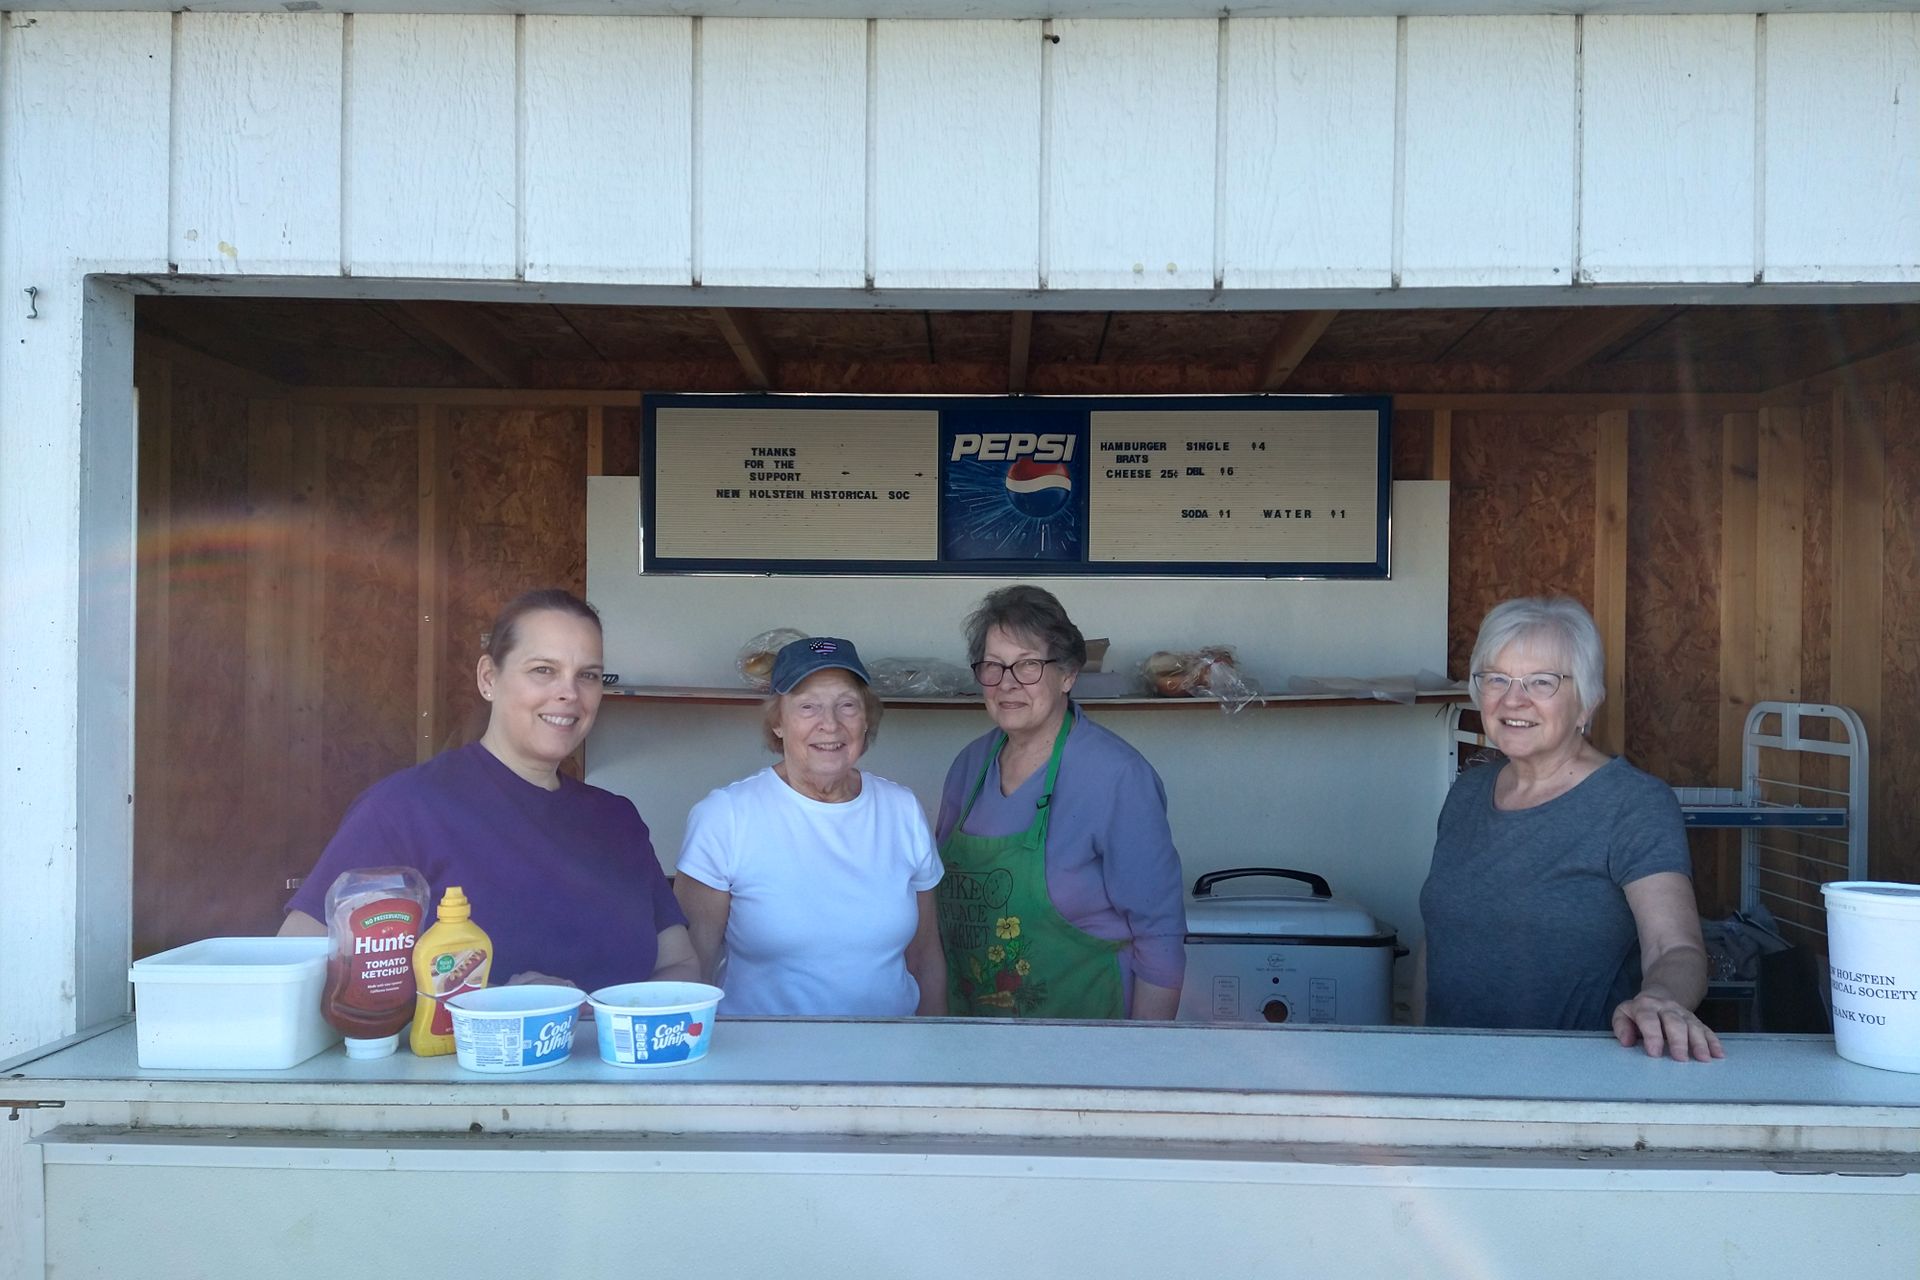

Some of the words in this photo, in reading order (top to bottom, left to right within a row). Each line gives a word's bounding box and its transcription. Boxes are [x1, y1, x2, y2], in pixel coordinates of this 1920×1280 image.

[752, 448, 796, 457] THANKS
[951, 433, 1077, 461] PEPSI
[1100, 442, 1167, 451] HAMBURGER
[744, 460, 764, 469] FOR
[774, 460, 794, 469] THE
[1116, 455, 1149, 464] BRATS
[749, 472, 801, 482] SUPPORT
[1106, 469, 1151, 478] CHEESE
[1186, 467, 1205, 476] DBL
[716, 489, 741, 498] NEW
[888, 491, 910, 500] SOC
[1181, 509, 1209, 518] SODA
[1263, 509, 1312, 518] WATER
[940, 875, 981, 900] PIKE
[373, 913, 411, 922] PRESERVATIVES
[940, 903, 987, 922] PLACE
[366, 957, 406, 969] TOMATO
[361, 965, 409, 980] KETCHUP
[1836, 968, 1896, 986] HOLSTEIN
[1858, 986, 1918, 1000] SOCIETY
[1858, 1012, 1887, 1026] YOU
[539, 1015, 572, 1041] Cool
[655, 1021, 684, 1038] Cool
[533, 1031, 572, 1058] Whip
[651, 1033, 687, 1050] Whip
